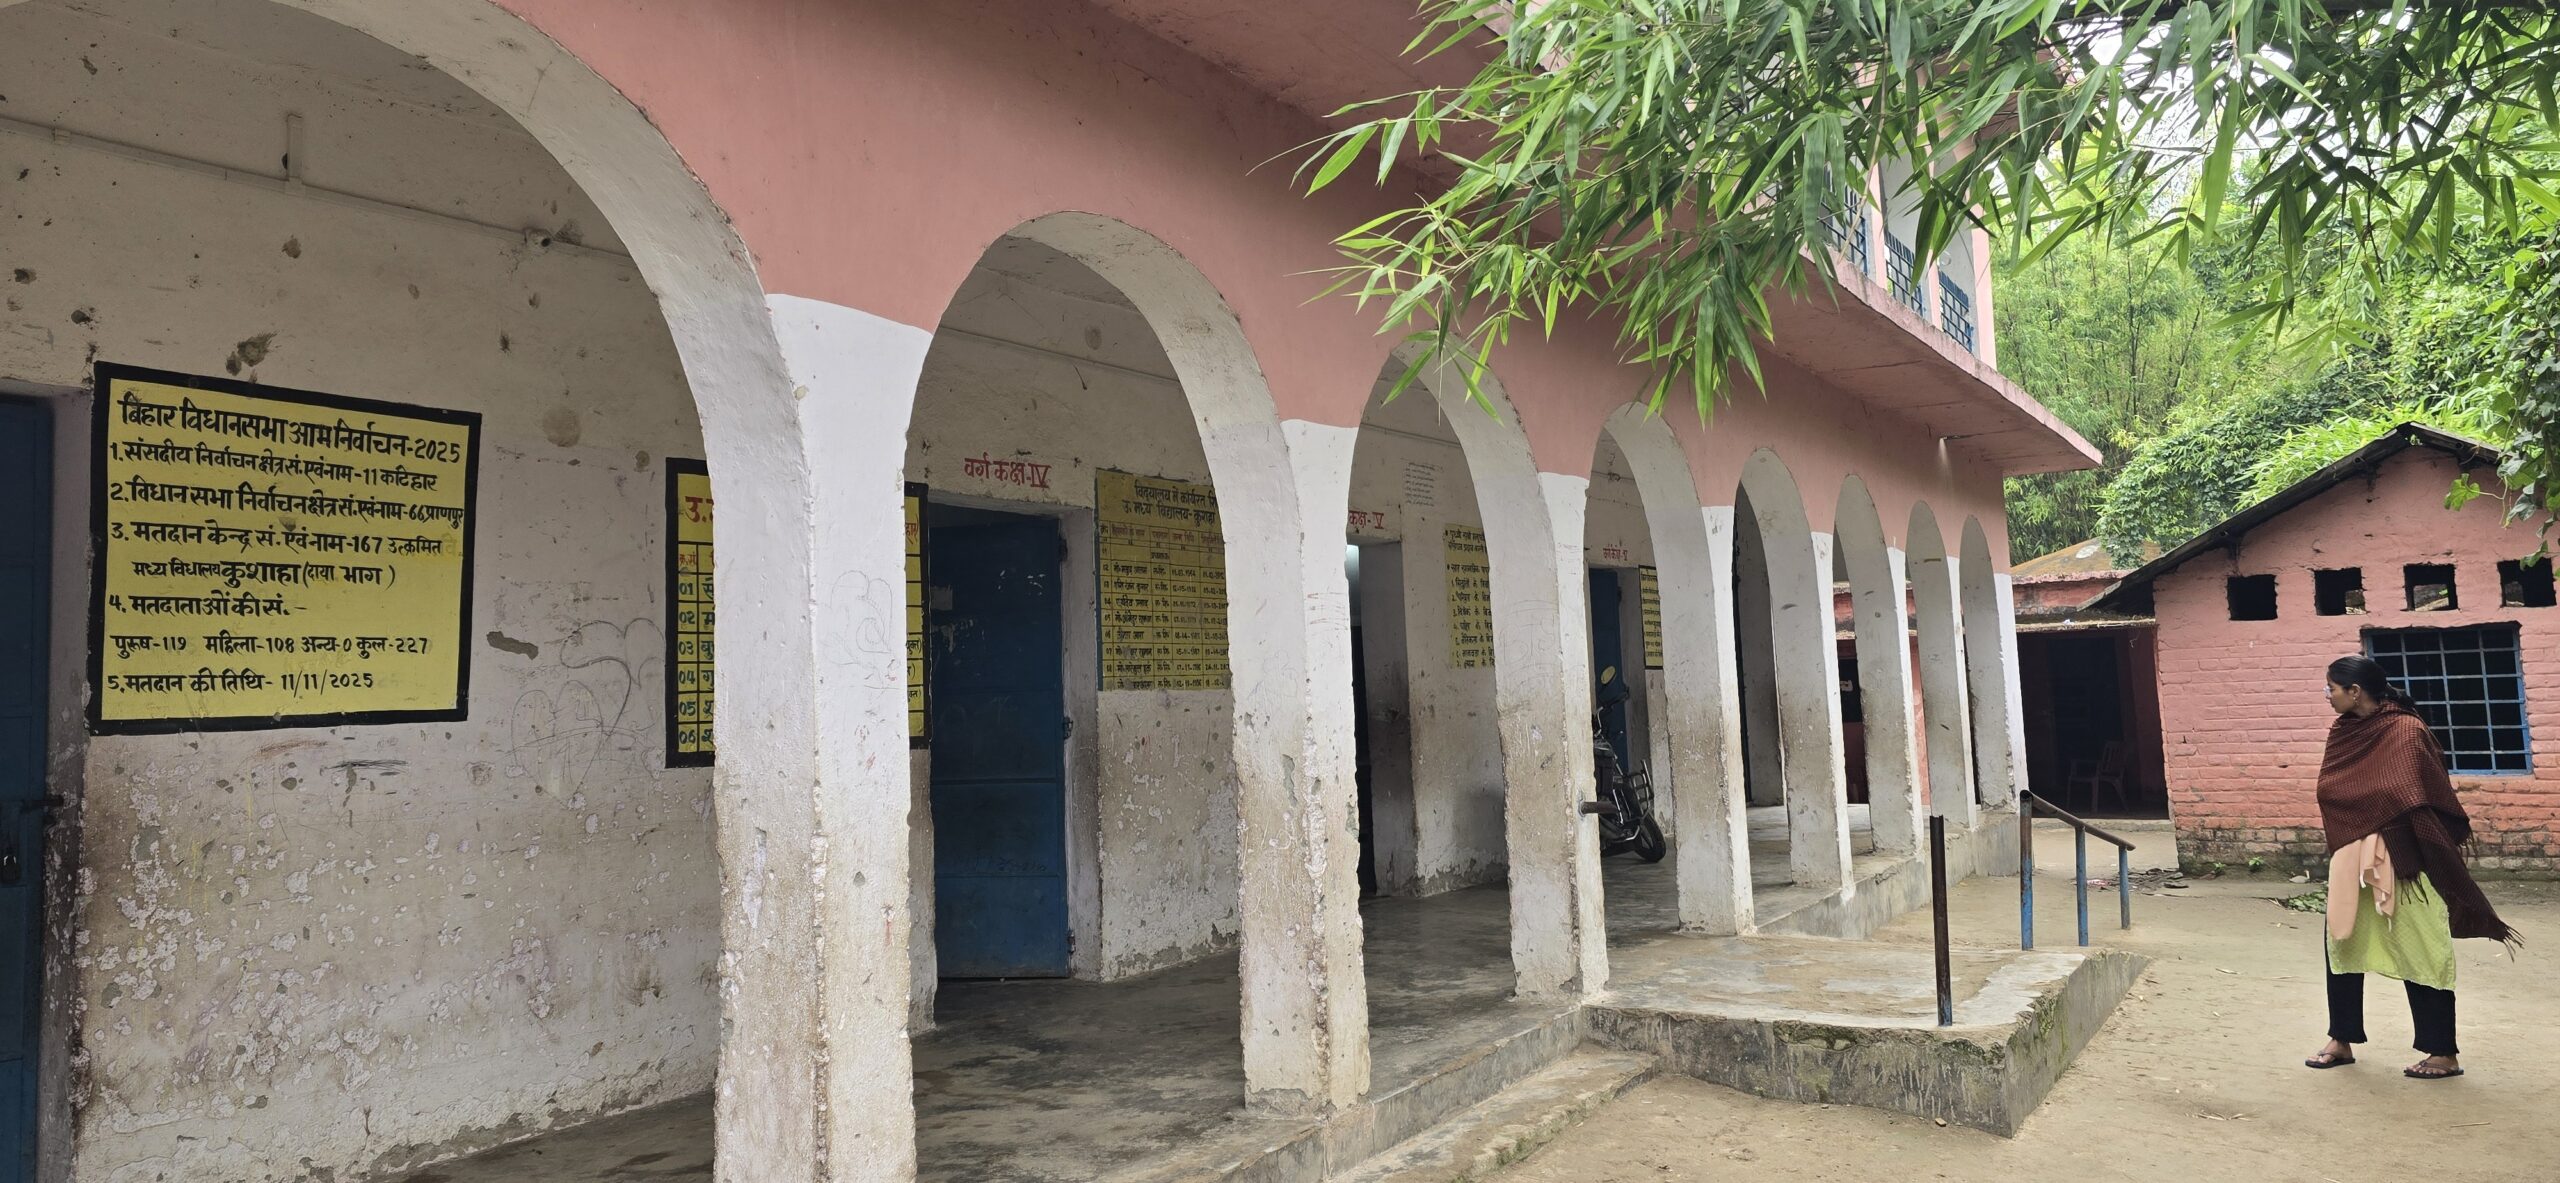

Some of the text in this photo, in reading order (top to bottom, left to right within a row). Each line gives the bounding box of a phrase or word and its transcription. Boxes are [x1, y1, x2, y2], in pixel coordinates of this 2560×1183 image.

[117, 391, 177, 428] बिहार
[179, 397, 288, 444] विधानसभा
[289, 421, 332, 449] आम
[194, 442, 259, 471] निर्वाचन
[380, 465, 437, 492] कटिहार
[964, 451, 991, 479] वर्ग
[235, 481, 308, 514] निर्वाचन
[130, 521, 205, 546] मतदान
[205, 519, 252, 553] केन्द्र
[132, 562, 168, 577] मध्य
[220, 561, 301, 588] कुशाहा
[680, 582, 693, 595] 01
[128, 589, 231, 616] मतदाताओं
[231, 591, 260, 617] की
[679, 611, 695, 624] 02
[679, 641, 694, 655] 03
[123, 674, 187, 696] मतदान
[188, 666, 218, 693] की
[281, 669, 373, 698] 11/11/2025
[679, 670, 695, 684] 04
[680, 701, 696, 716] 05
[680, 729, 696, 744] 06
